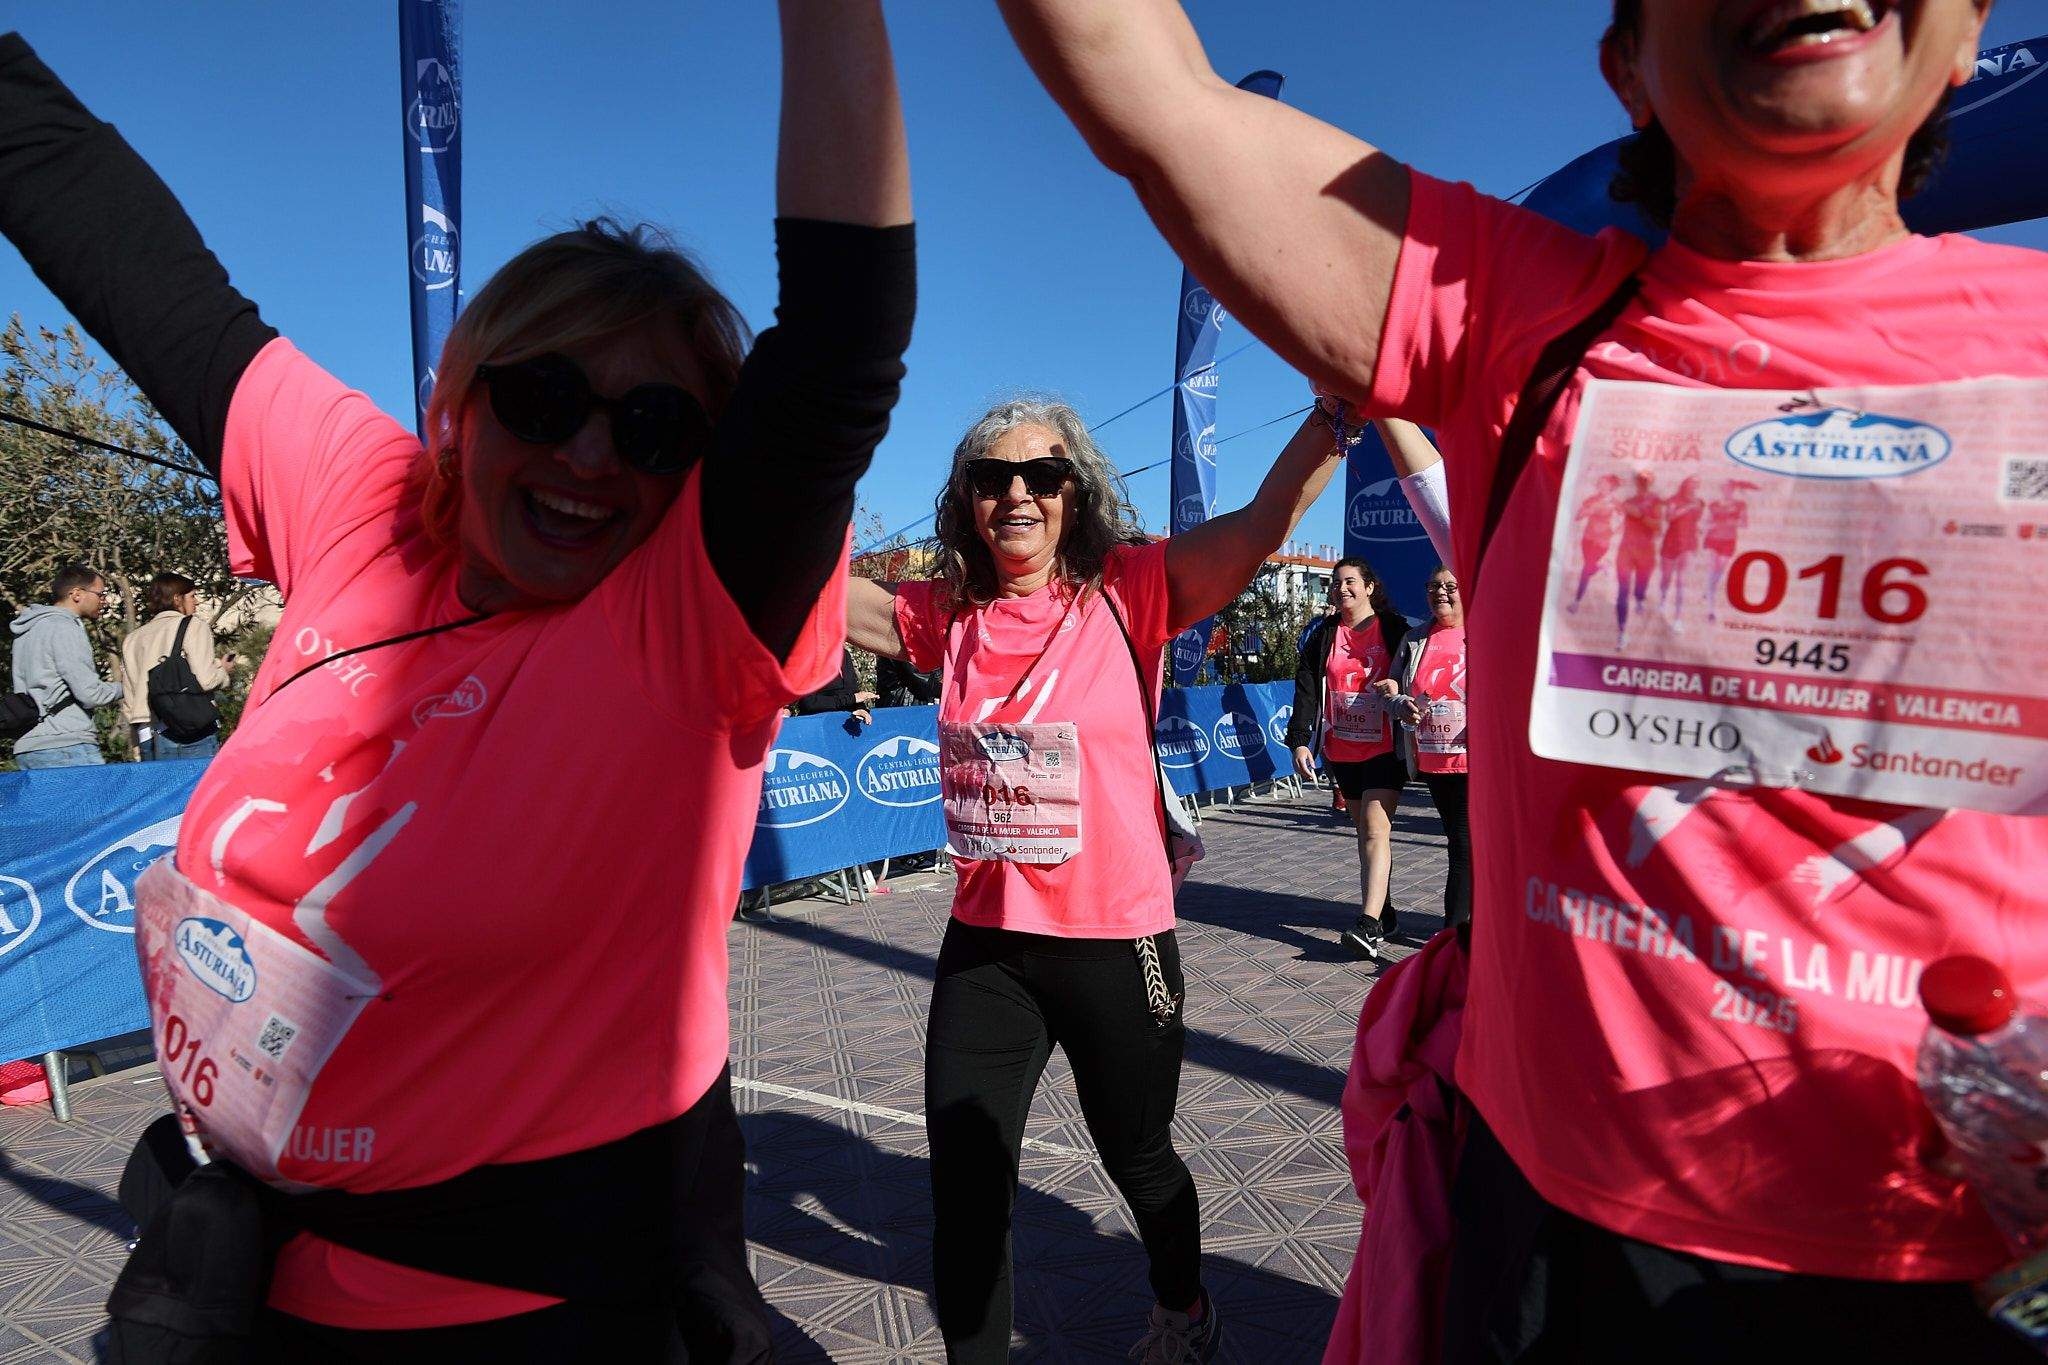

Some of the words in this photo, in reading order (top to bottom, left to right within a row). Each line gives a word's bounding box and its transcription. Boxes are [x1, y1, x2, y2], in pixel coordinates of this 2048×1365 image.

[1742, 431, 1931, 462] ASTURIANA
[1726, 550, 1930, 625] 016
[1756, 638, 1850, 673] 9445
[1602, 664, 1704, 695] CARRERA
[1711, 676, 1743, 699] DE
[1749, 678, 1778, 703] LA
[1784, 682, 1871, 712] MUJER
[1895, 693, 2022, 728] VALENCIA
[1430, 724, 1451, 734] 016
[1589, 708, 1741, 754] OYSHO
[1851, 743, 2025, 788] Santander
[983, 785, 1033, 807] 016
[993, 812, 1012, 824] 962
[999, 827, 1021, 836] MUJER
[1026, 827, 1060, 836] VALENCIA
[1018, 844, 1064, 855] Santander
[1525, 874, 1698, 964] CARRERA
[1712, 924, 1769, 982] DE
[1780, 936, 1833, 996] LA
[1711, 979, 1798, 1035] 2025
[164, 1014, 219, 1108] 016
